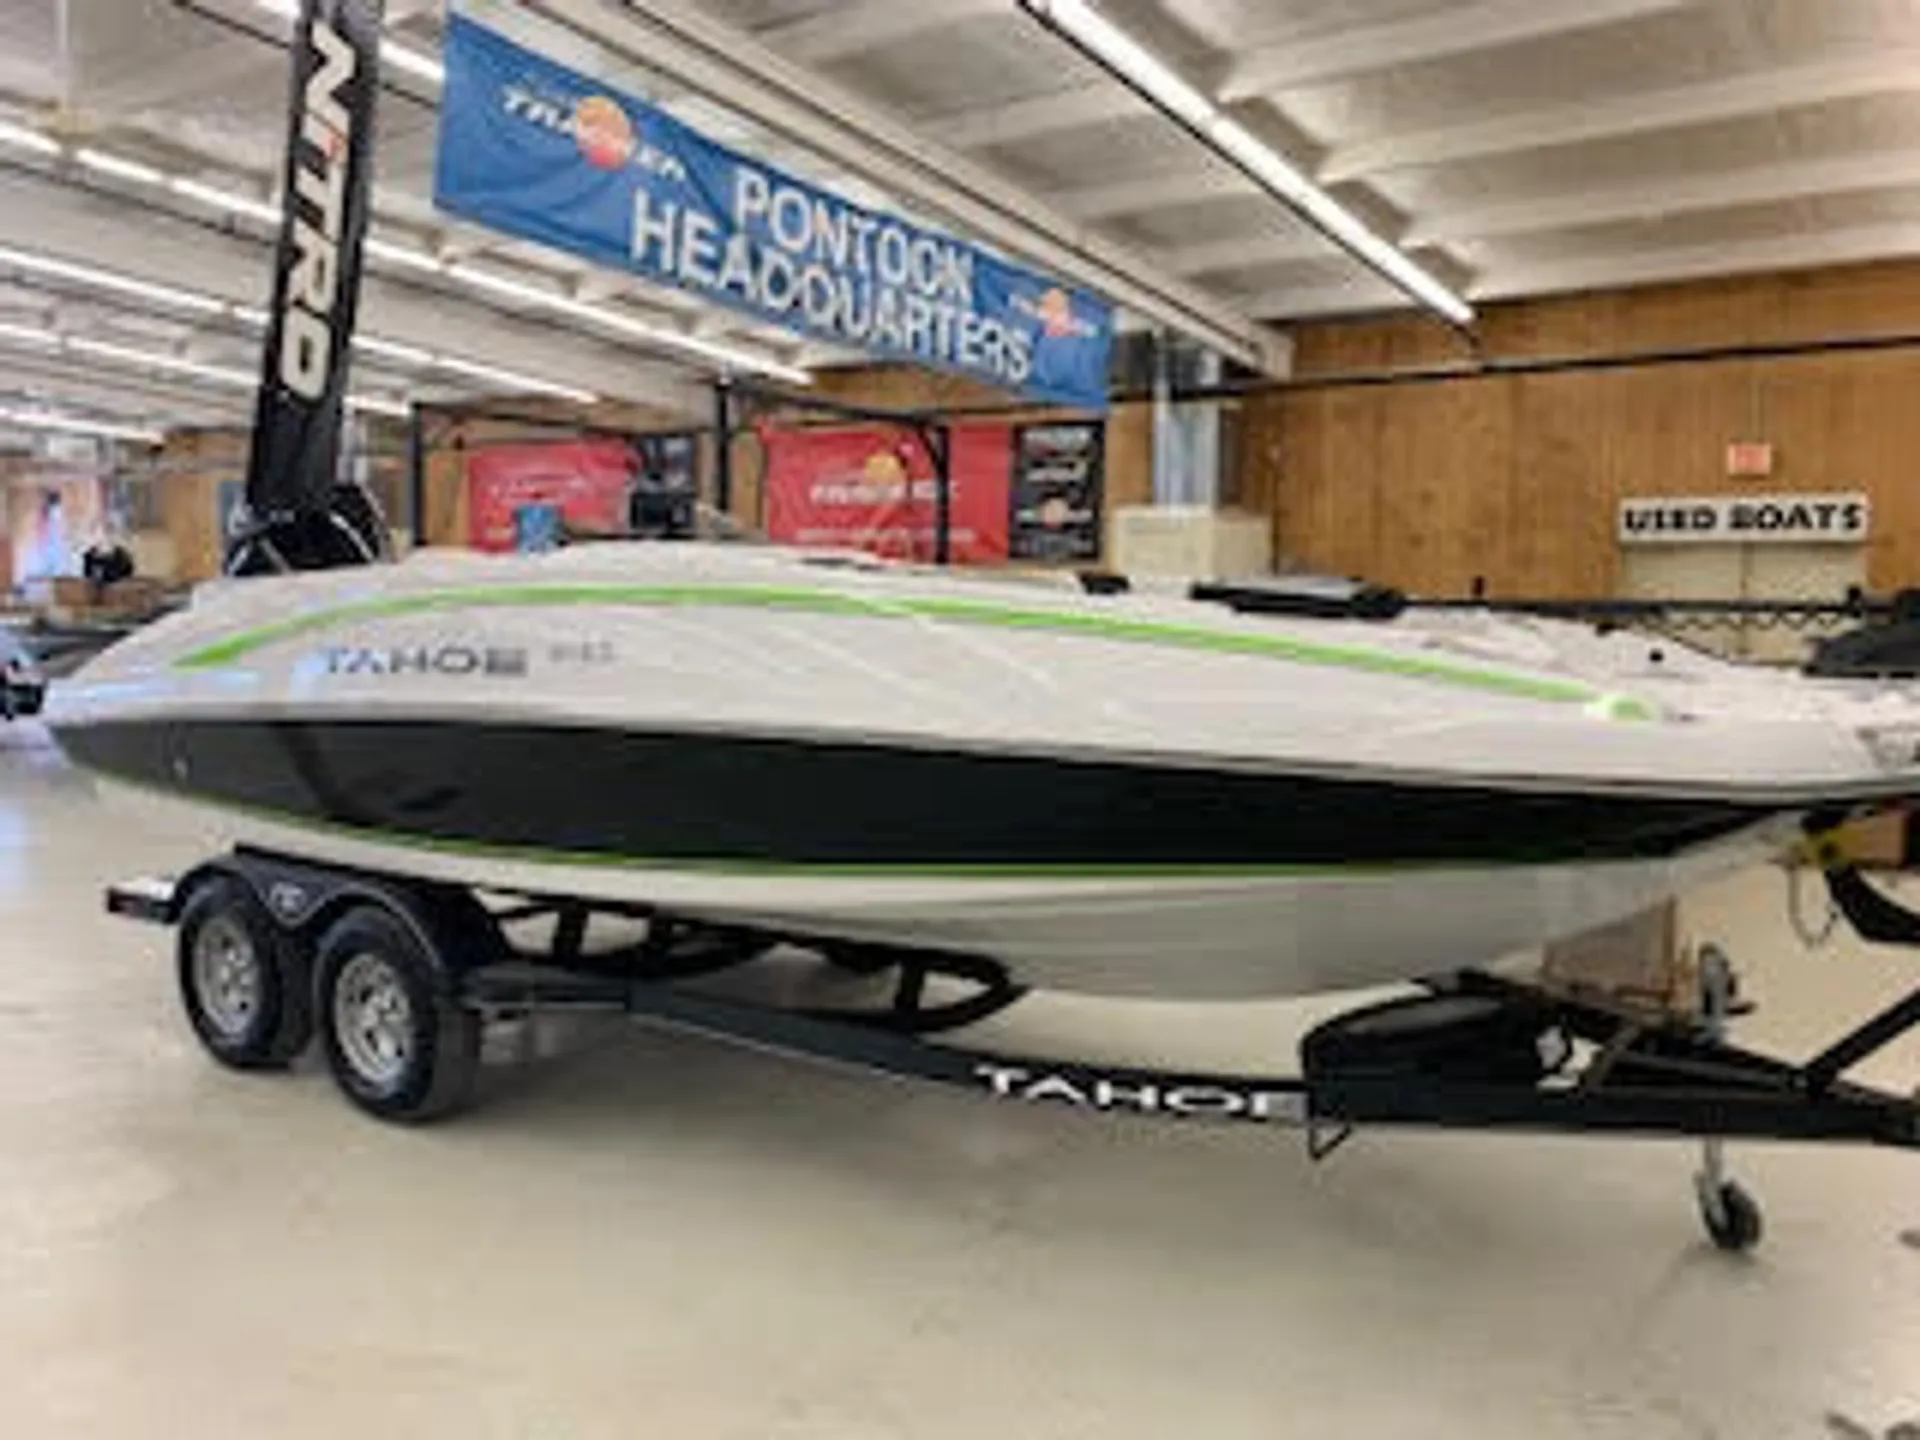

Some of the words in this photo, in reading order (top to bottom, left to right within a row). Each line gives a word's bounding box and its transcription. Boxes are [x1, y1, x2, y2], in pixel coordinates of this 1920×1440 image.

[502, 84, 686, 182] TRAER
[280, 20, 356, 400] NITRO
[734, 166, 975, 300] PONTOON
[629, 185, 1033, 384] HEADQUARTERS
[1623, 507, 1718, 532] USED
[1729, 503, 1864, 530] BOATS
[322, 646, 528, 677] TAHOE
[974, 1063, 1308, 1120] TAHOE
